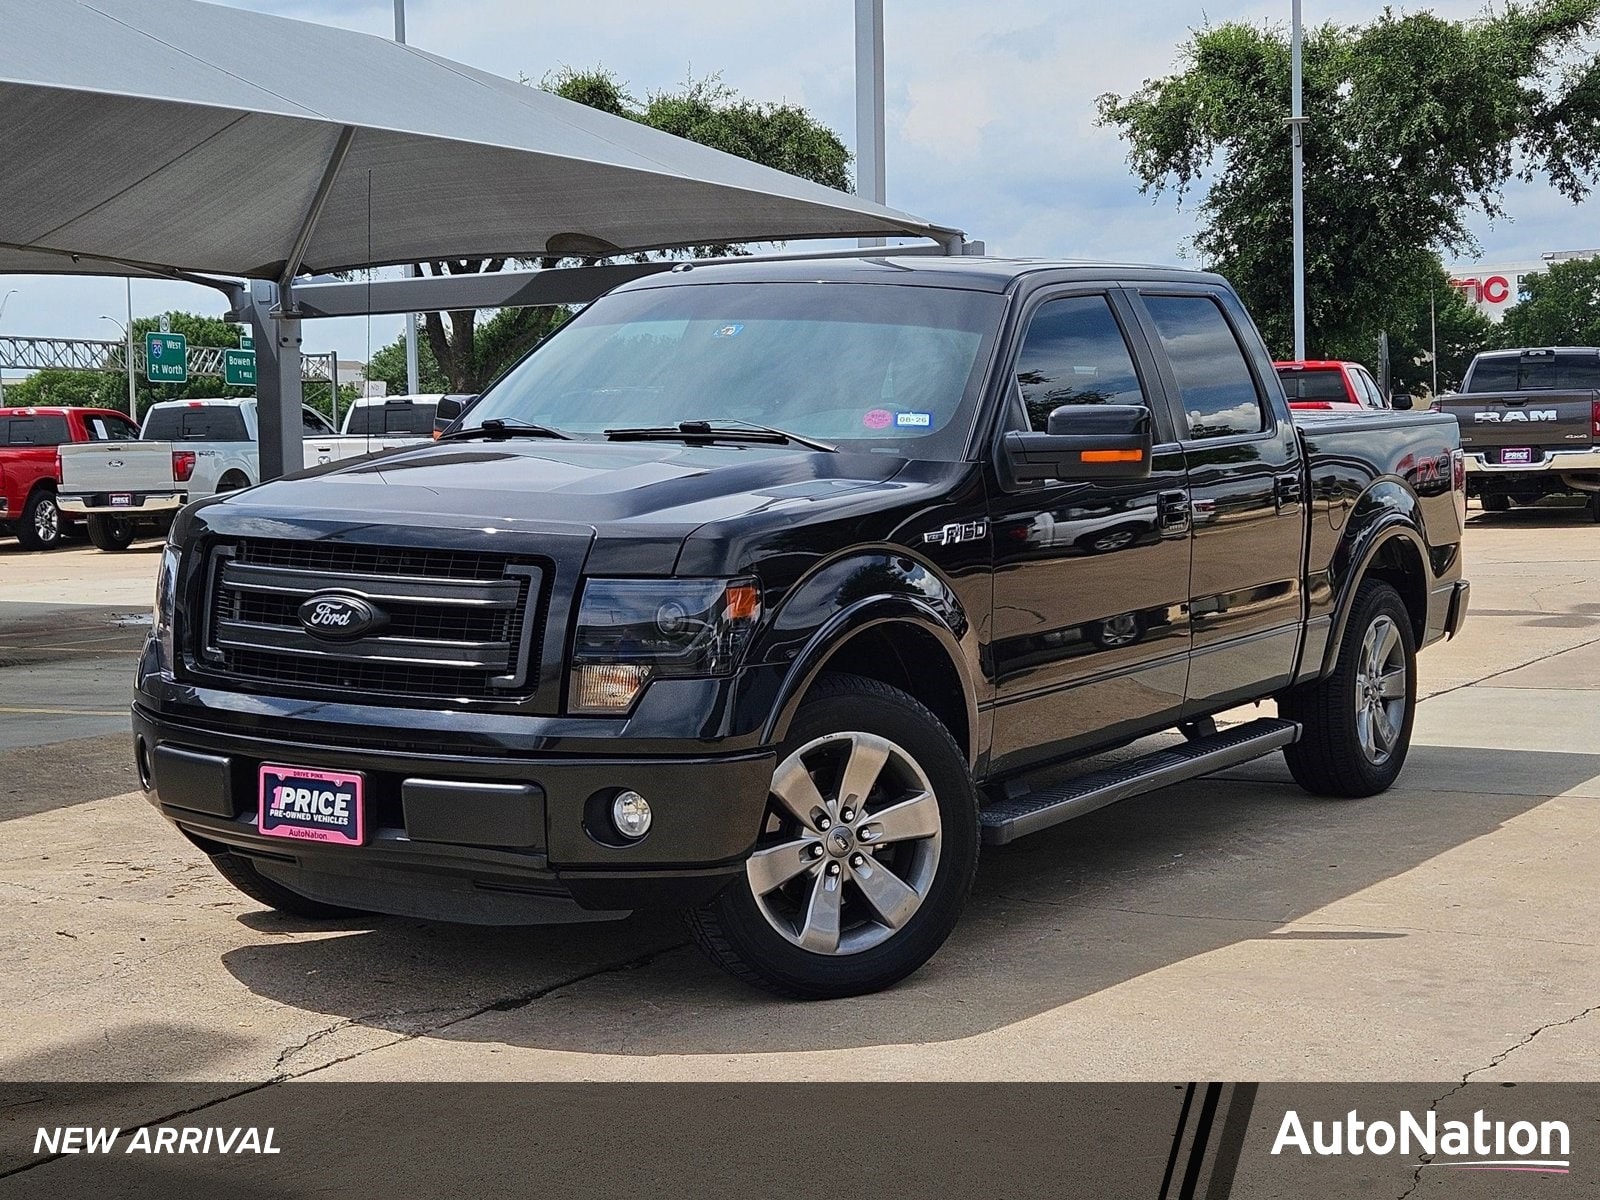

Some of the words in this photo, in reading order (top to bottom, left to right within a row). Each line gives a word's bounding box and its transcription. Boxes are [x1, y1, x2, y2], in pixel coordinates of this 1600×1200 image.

[1449, 276, 1509, 303] mc
[153, 344, 161, 354] 20
[166, 340, 181, 350] WEST
[228, 355, 251, 366] Bowen
[151, 364, 159, 374] Ft
[162, 364, 183, 375] Worth
[1474, 410, 1557, 423] RAM
[1417, 455, 1449, 482] FX2
[311, 602, 351, 626] Ford
[270, 786, 352, 817] 1PRICE
[269, 808, 312, 821] PRE-OWNED
[312, 814, 349, 826] VEHICLES
[289, 829, 328, 840] AutoNation
